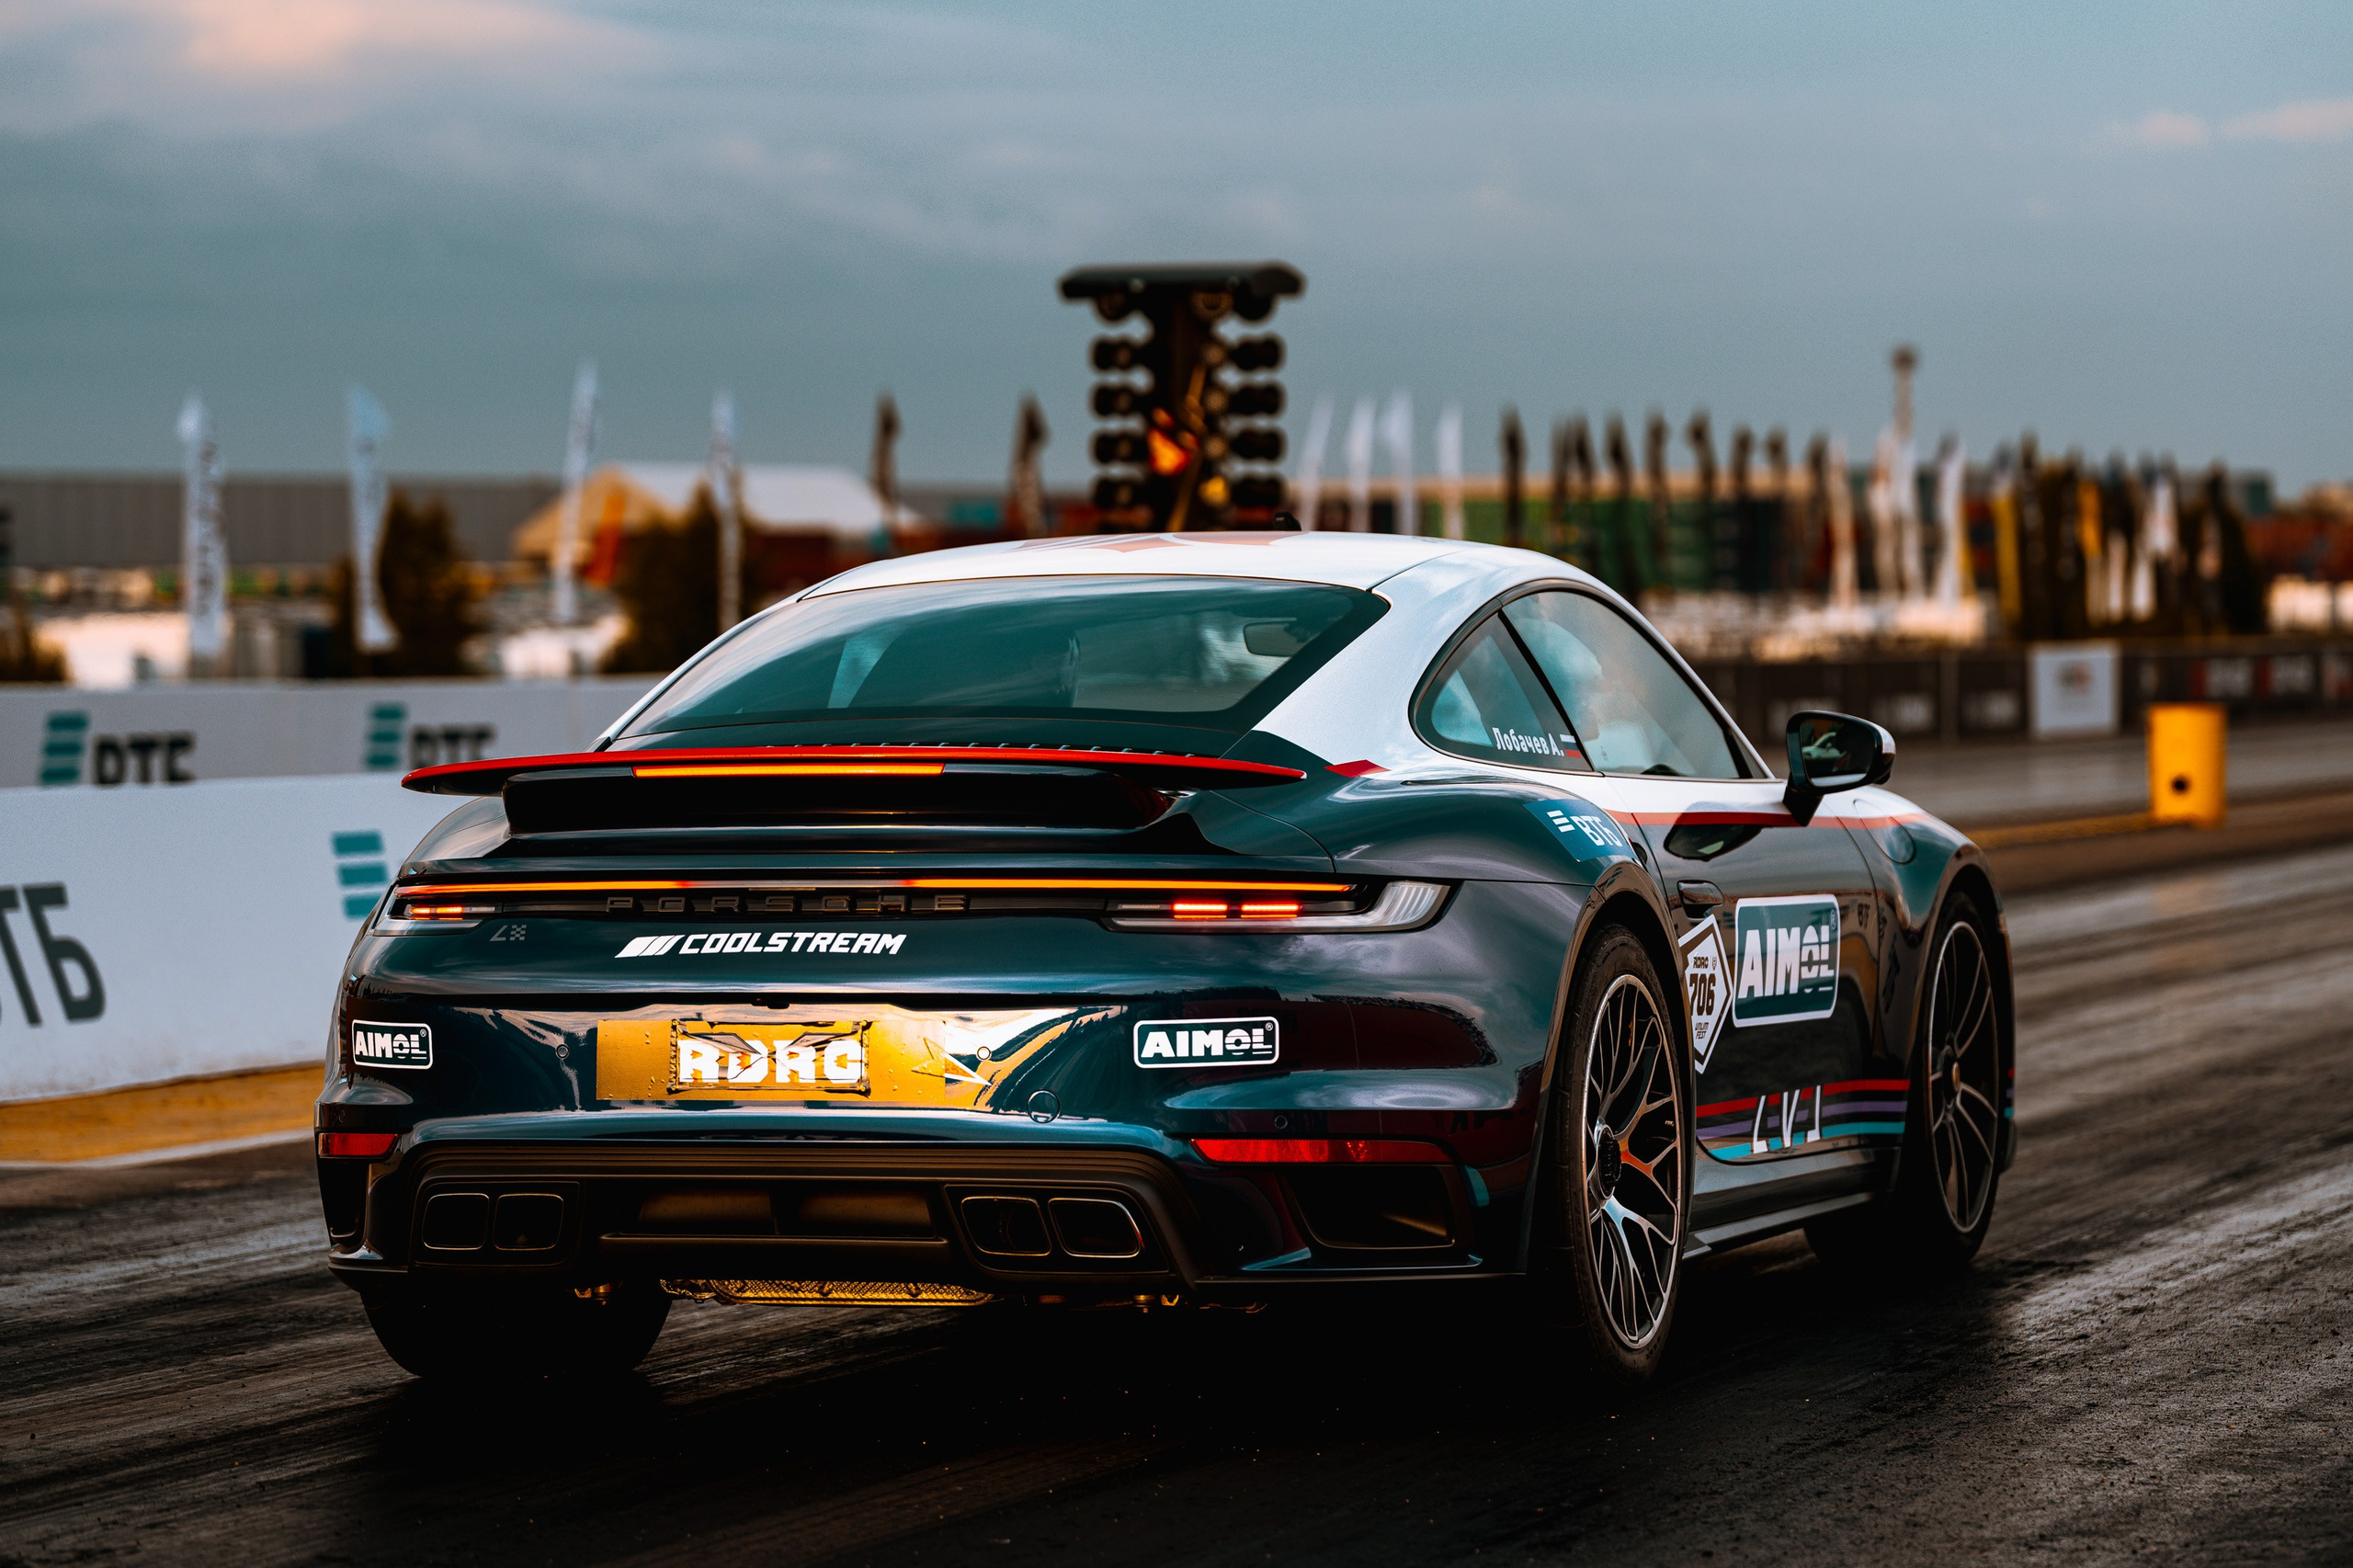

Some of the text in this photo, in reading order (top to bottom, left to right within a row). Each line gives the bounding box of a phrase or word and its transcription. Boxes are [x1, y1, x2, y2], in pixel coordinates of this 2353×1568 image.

[1492, 727, 1550, 756] Лобачев
[1569, 815, 1623, 847] ВТБ
[606, 894, 967, 914] PORSCHE
[0, 881, 107, 1028] ТБ
[678, 932, 907, 956] COOLSTREAM
[1689, 972, 1716, 1017] 706
[678, 1040, 861, 1084] RDRC
